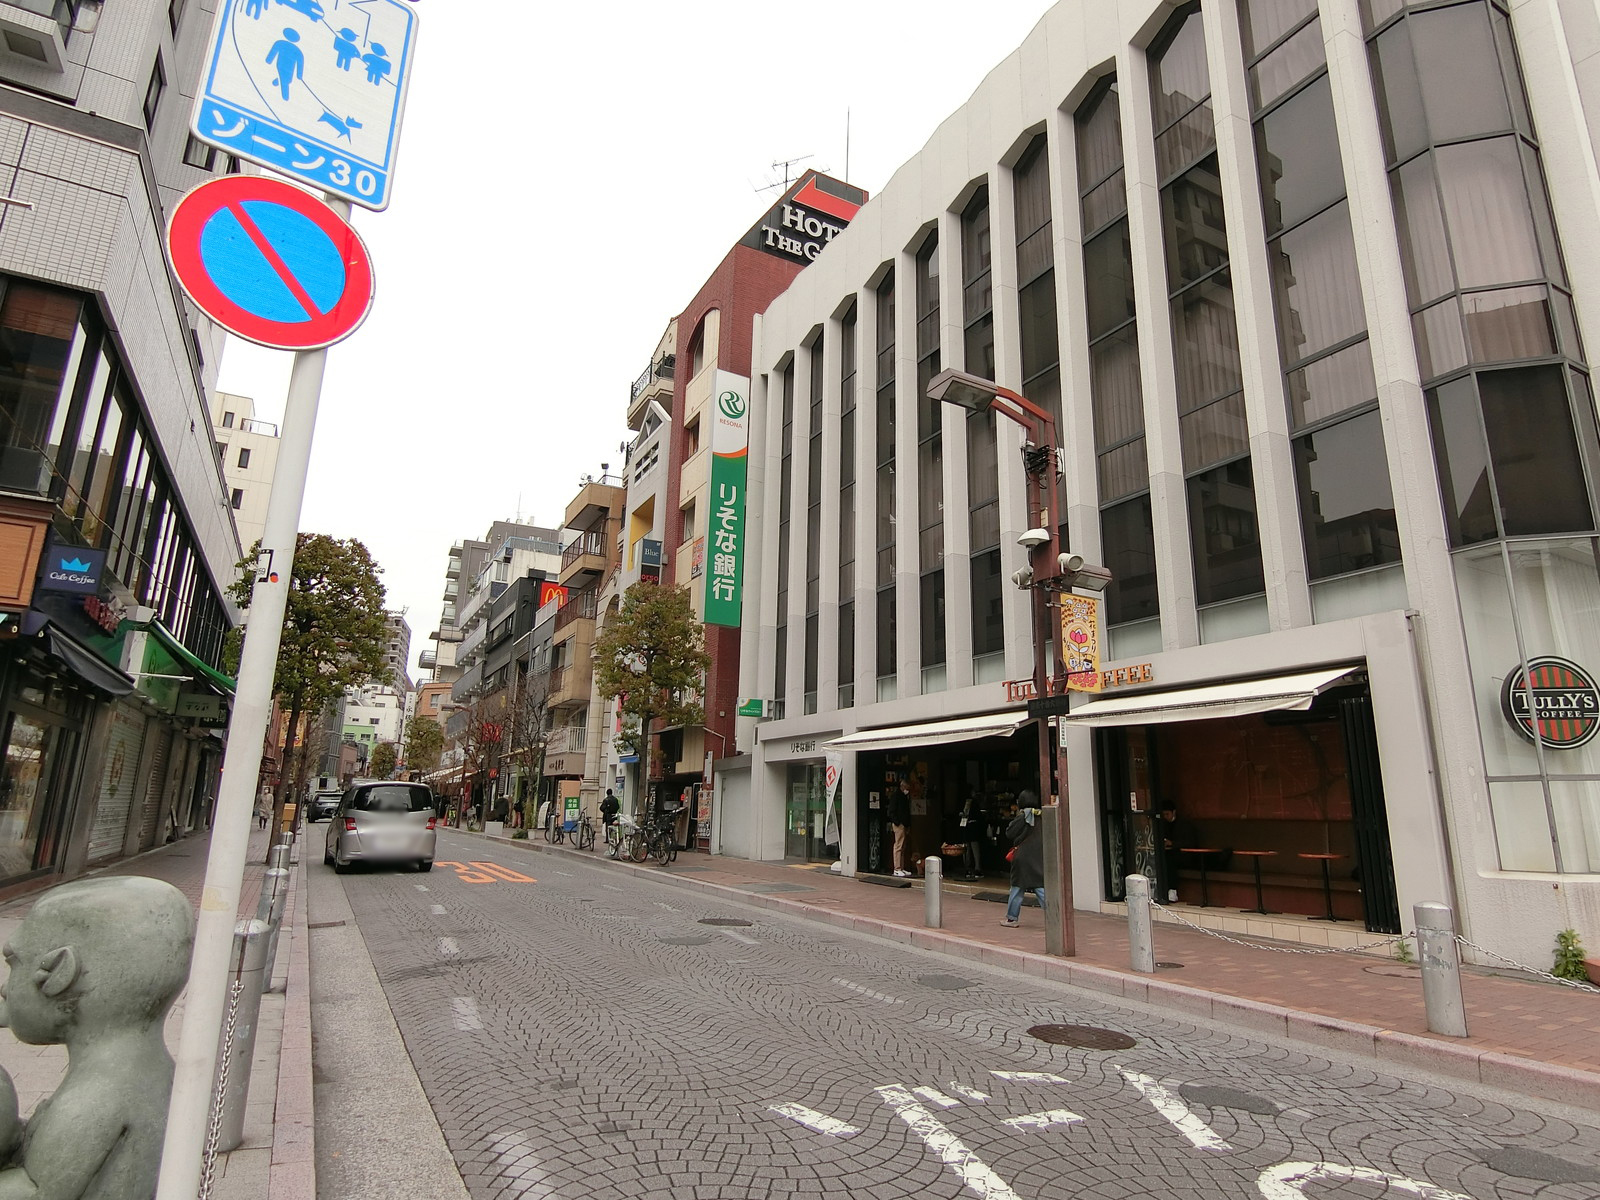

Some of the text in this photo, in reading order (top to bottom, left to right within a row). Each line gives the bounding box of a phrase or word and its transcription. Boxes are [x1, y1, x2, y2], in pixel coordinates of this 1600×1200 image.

[211, 109, 377, 197] ゾーン30
[782, 204, 846, 242] HOT
[719, 418, 743, 429] RESONA
[712, 483, 738, 602] りそな銀行
[644, 548, 660, 557] Blue
[68, 573, 96, 585] Coffee
[790, 740, 816, 754] りそな銀行
[433, 861, 538, 884] 30
